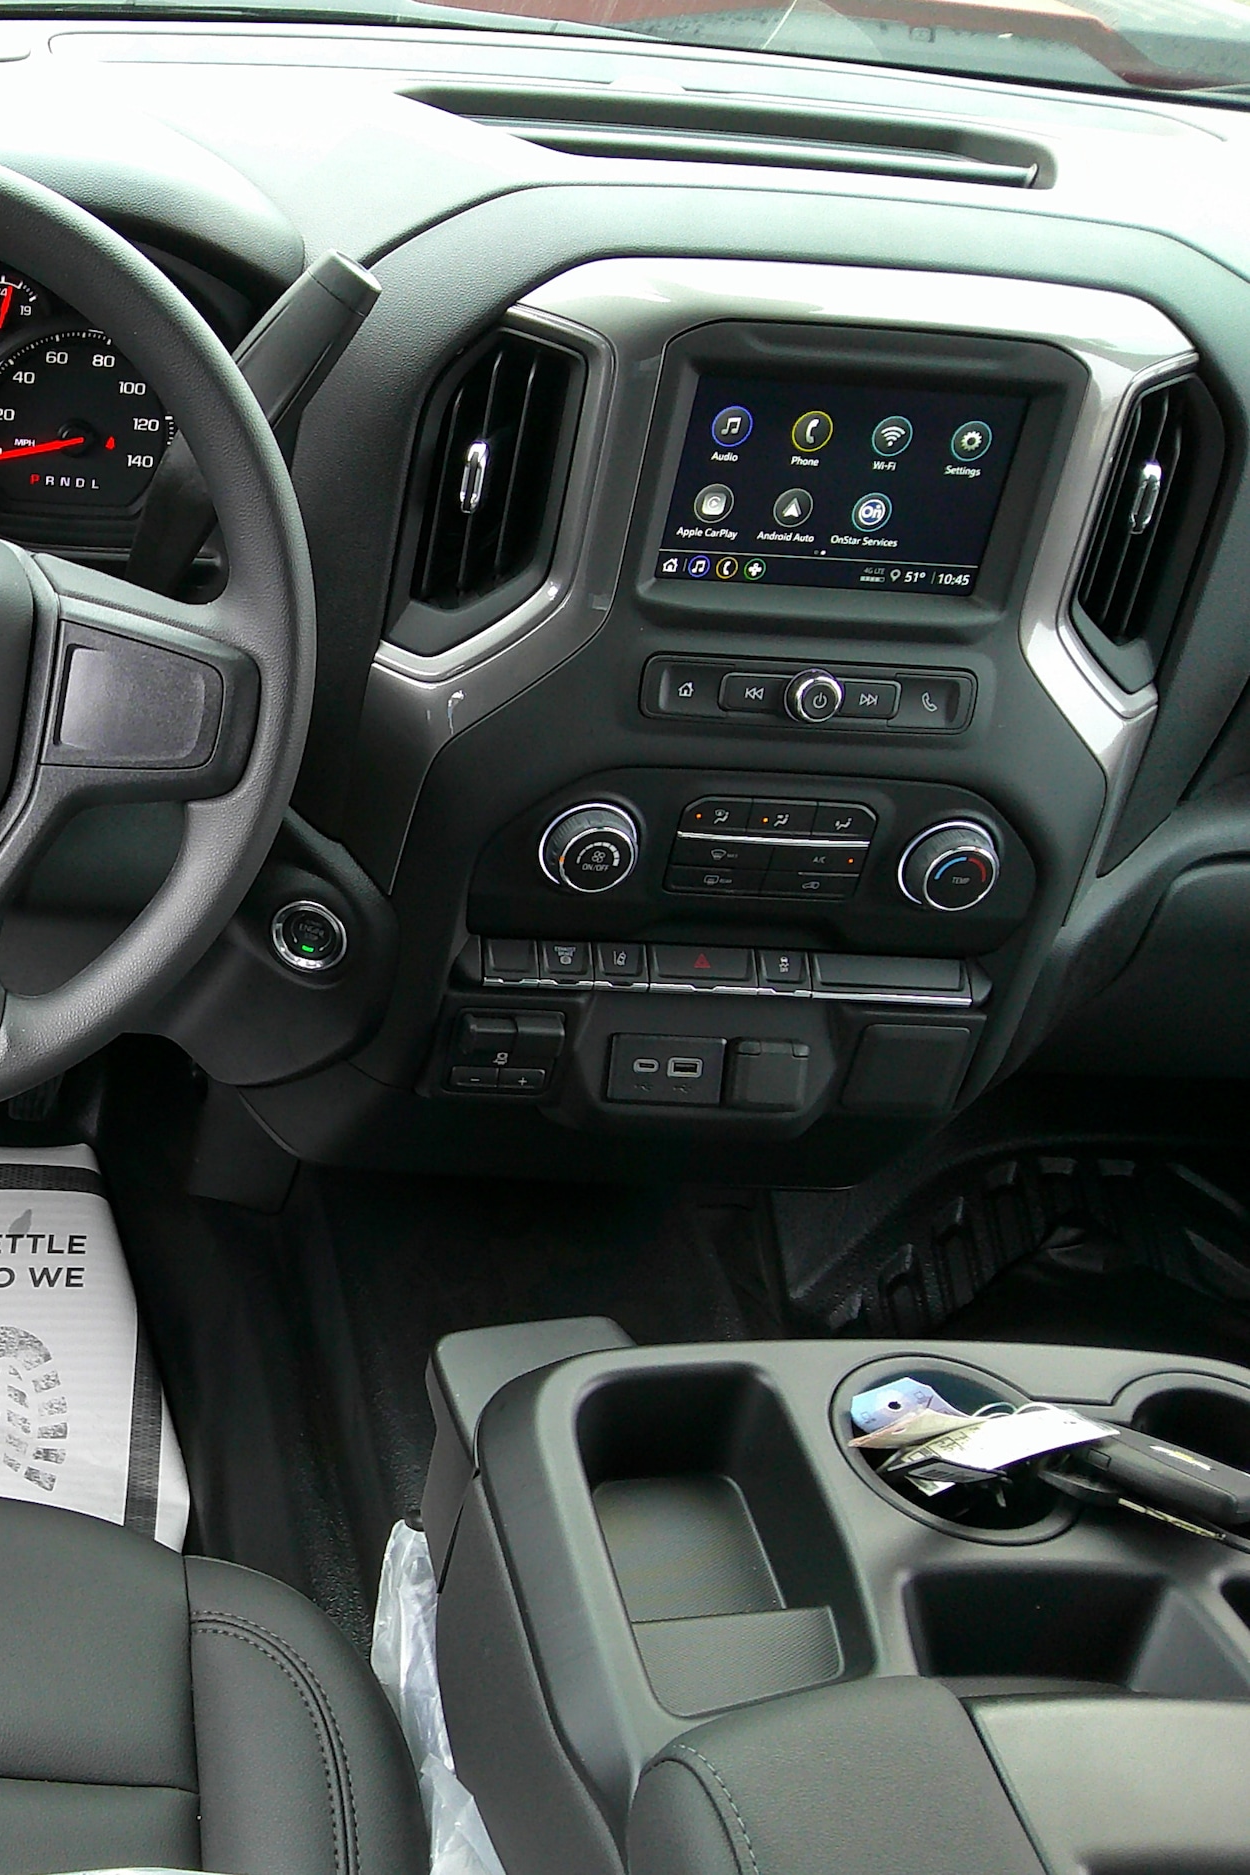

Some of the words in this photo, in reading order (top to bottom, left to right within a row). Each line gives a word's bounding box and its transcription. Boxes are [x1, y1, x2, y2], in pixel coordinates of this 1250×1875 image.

[20, 306, 32, 316] 19
[46, 351, 68, 364] 60
[92, 354, 115, 368] 80
[12, 371, 36, 384] 40
[118, 381, 146, 395] 100
[132, 418, 160, 432] 120
[14, 438, 36, 447] MPH
[127, 454, 154, 468] 140
[710, 452, 738, 462] Audio
[790, 456, 820, 468] Phone
[872, 460, 896, 471] Wi-Fi
[944, 465, 981, 478] Settings
[30, 474, 40, 484] P
[46, 476, 54, 486] R
[60, 476, 70, 487] N
[76, 478, 85, 488] D
[92, 479, 100, 490] L
[676, 526, 702, 538] Apple
[704, 528, 738, 540] CarPlay
[757, 531, 792, 542] Android
[793, 533, 814, 543] Auto
[830, 535, 861, 546] OnStar
[862, 537, 898, 548] Services
[938, 573, 970, 586] 10:45
[812, 856, 826, 864] A/C
[582, 863, 609, 872] ON/OFF
[28, 1267, 86, 1288] WE
